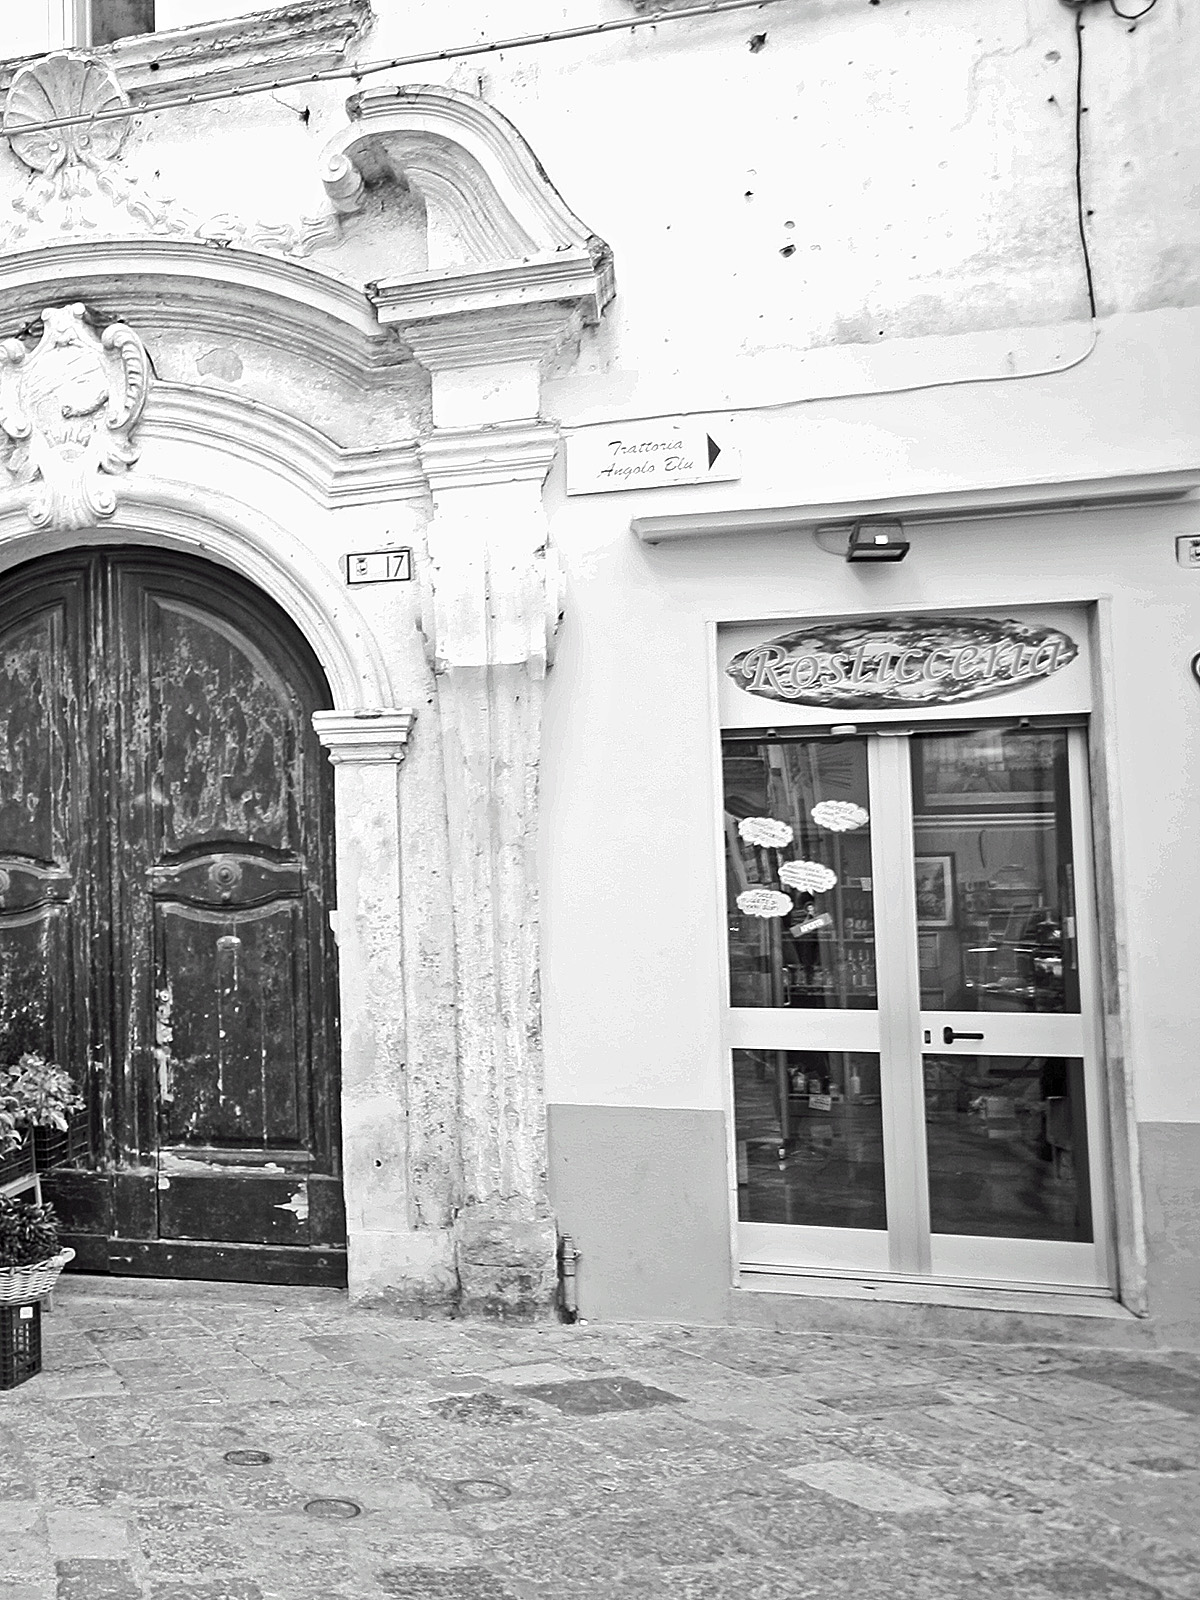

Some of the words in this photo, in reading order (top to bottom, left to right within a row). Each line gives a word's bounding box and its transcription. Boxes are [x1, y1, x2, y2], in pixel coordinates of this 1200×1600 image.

[607, 440, 684, 456] Trattoria
[597, 460, 656, 480] Angolo
[386, 554, 405, 578] 17
[741, 638, 1063, 699] Rosticceria
